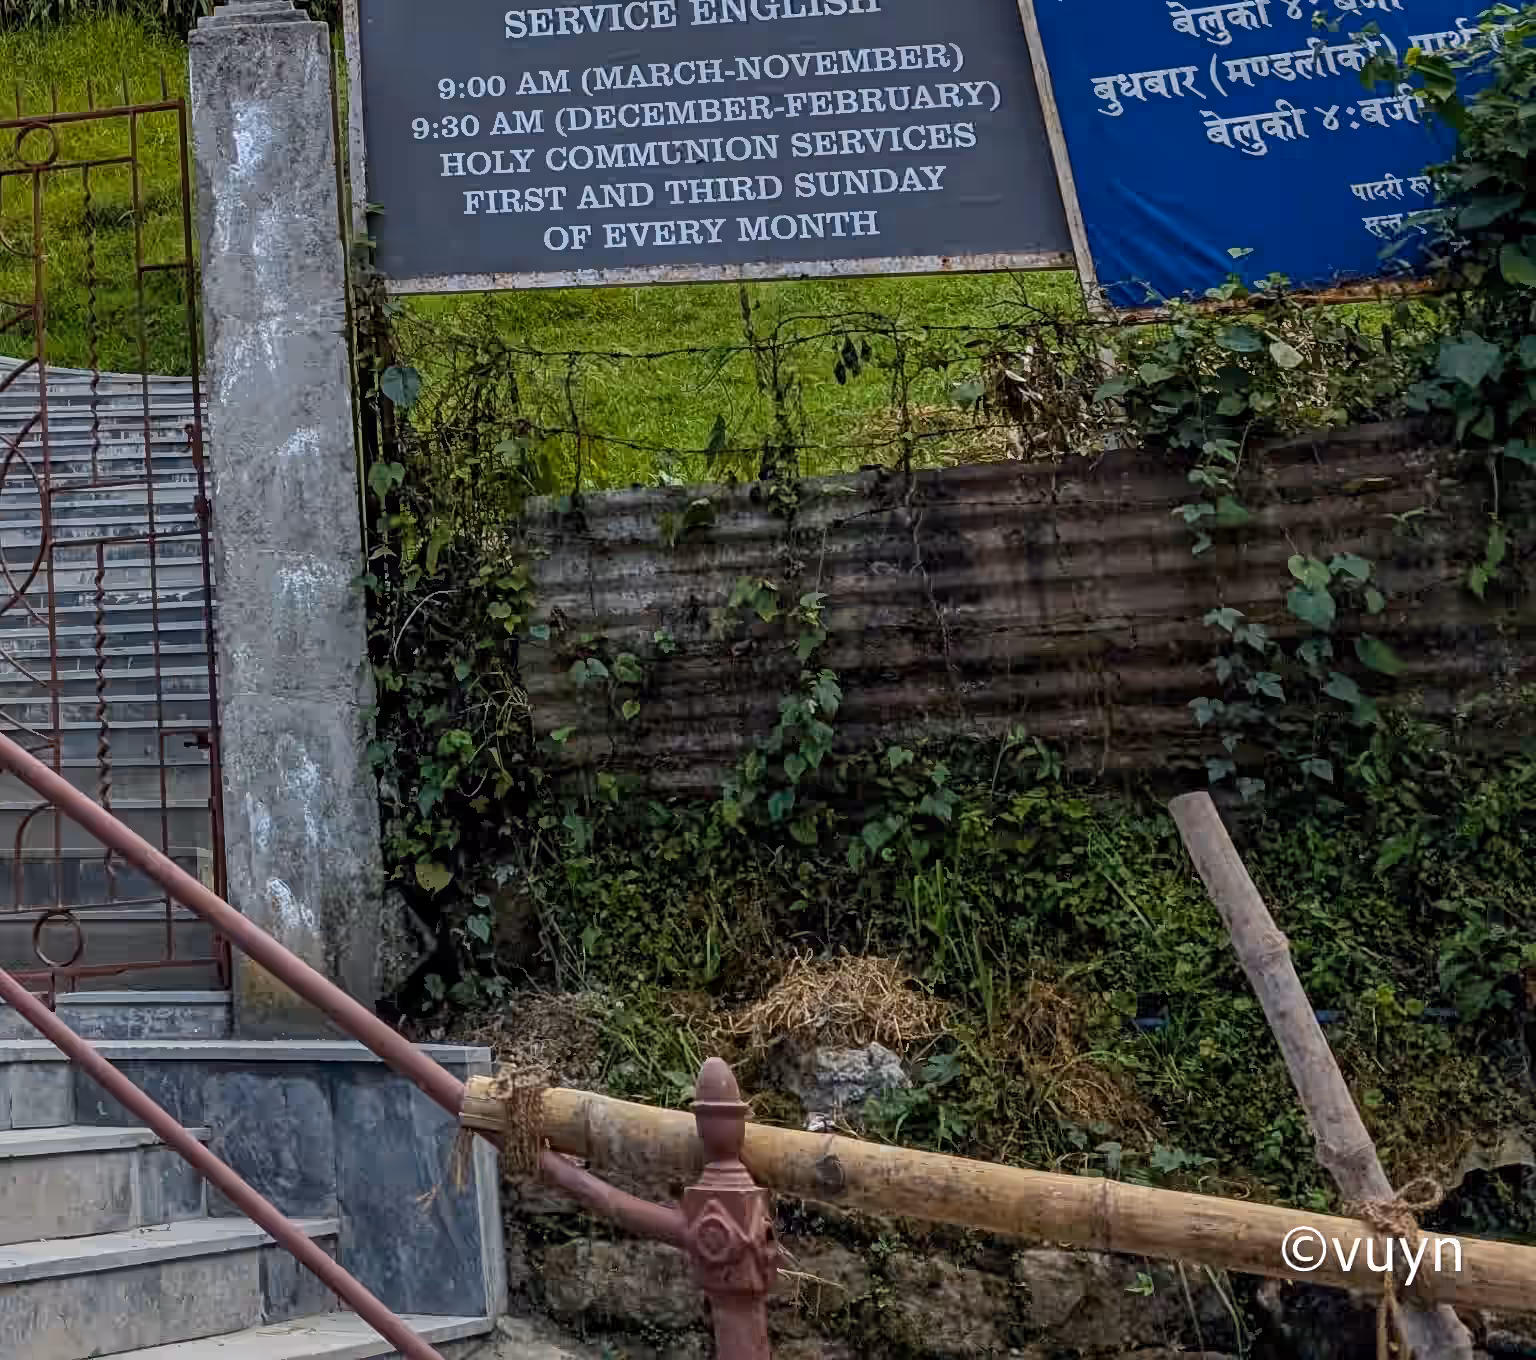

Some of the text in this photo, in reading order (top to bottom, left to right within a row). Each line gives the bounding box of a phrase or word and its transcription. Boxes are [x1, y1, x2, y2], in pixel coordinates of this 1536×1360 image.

[505, 0, 676, 38] SERVICE
[438, 43, 963, 99] 9:00 AM (MARCH-NOVEMBER)
[1091, 66, 1206, 116] बुधबार
[412, 82, 1000, 139] 9:30 AM (DECEMBER-FEBRUARY)
[1200, 99, 1309, 155] बेलुकी
[440, 123, 976, 176] HOLY COMMUNION SERVICES
[463, 166, 946, 214] FIRST AND THIRD SUNDAY
[1351, 174, 1404, 200] पादरी
[544, 211, 880, 250] OF EVERY MONTH
